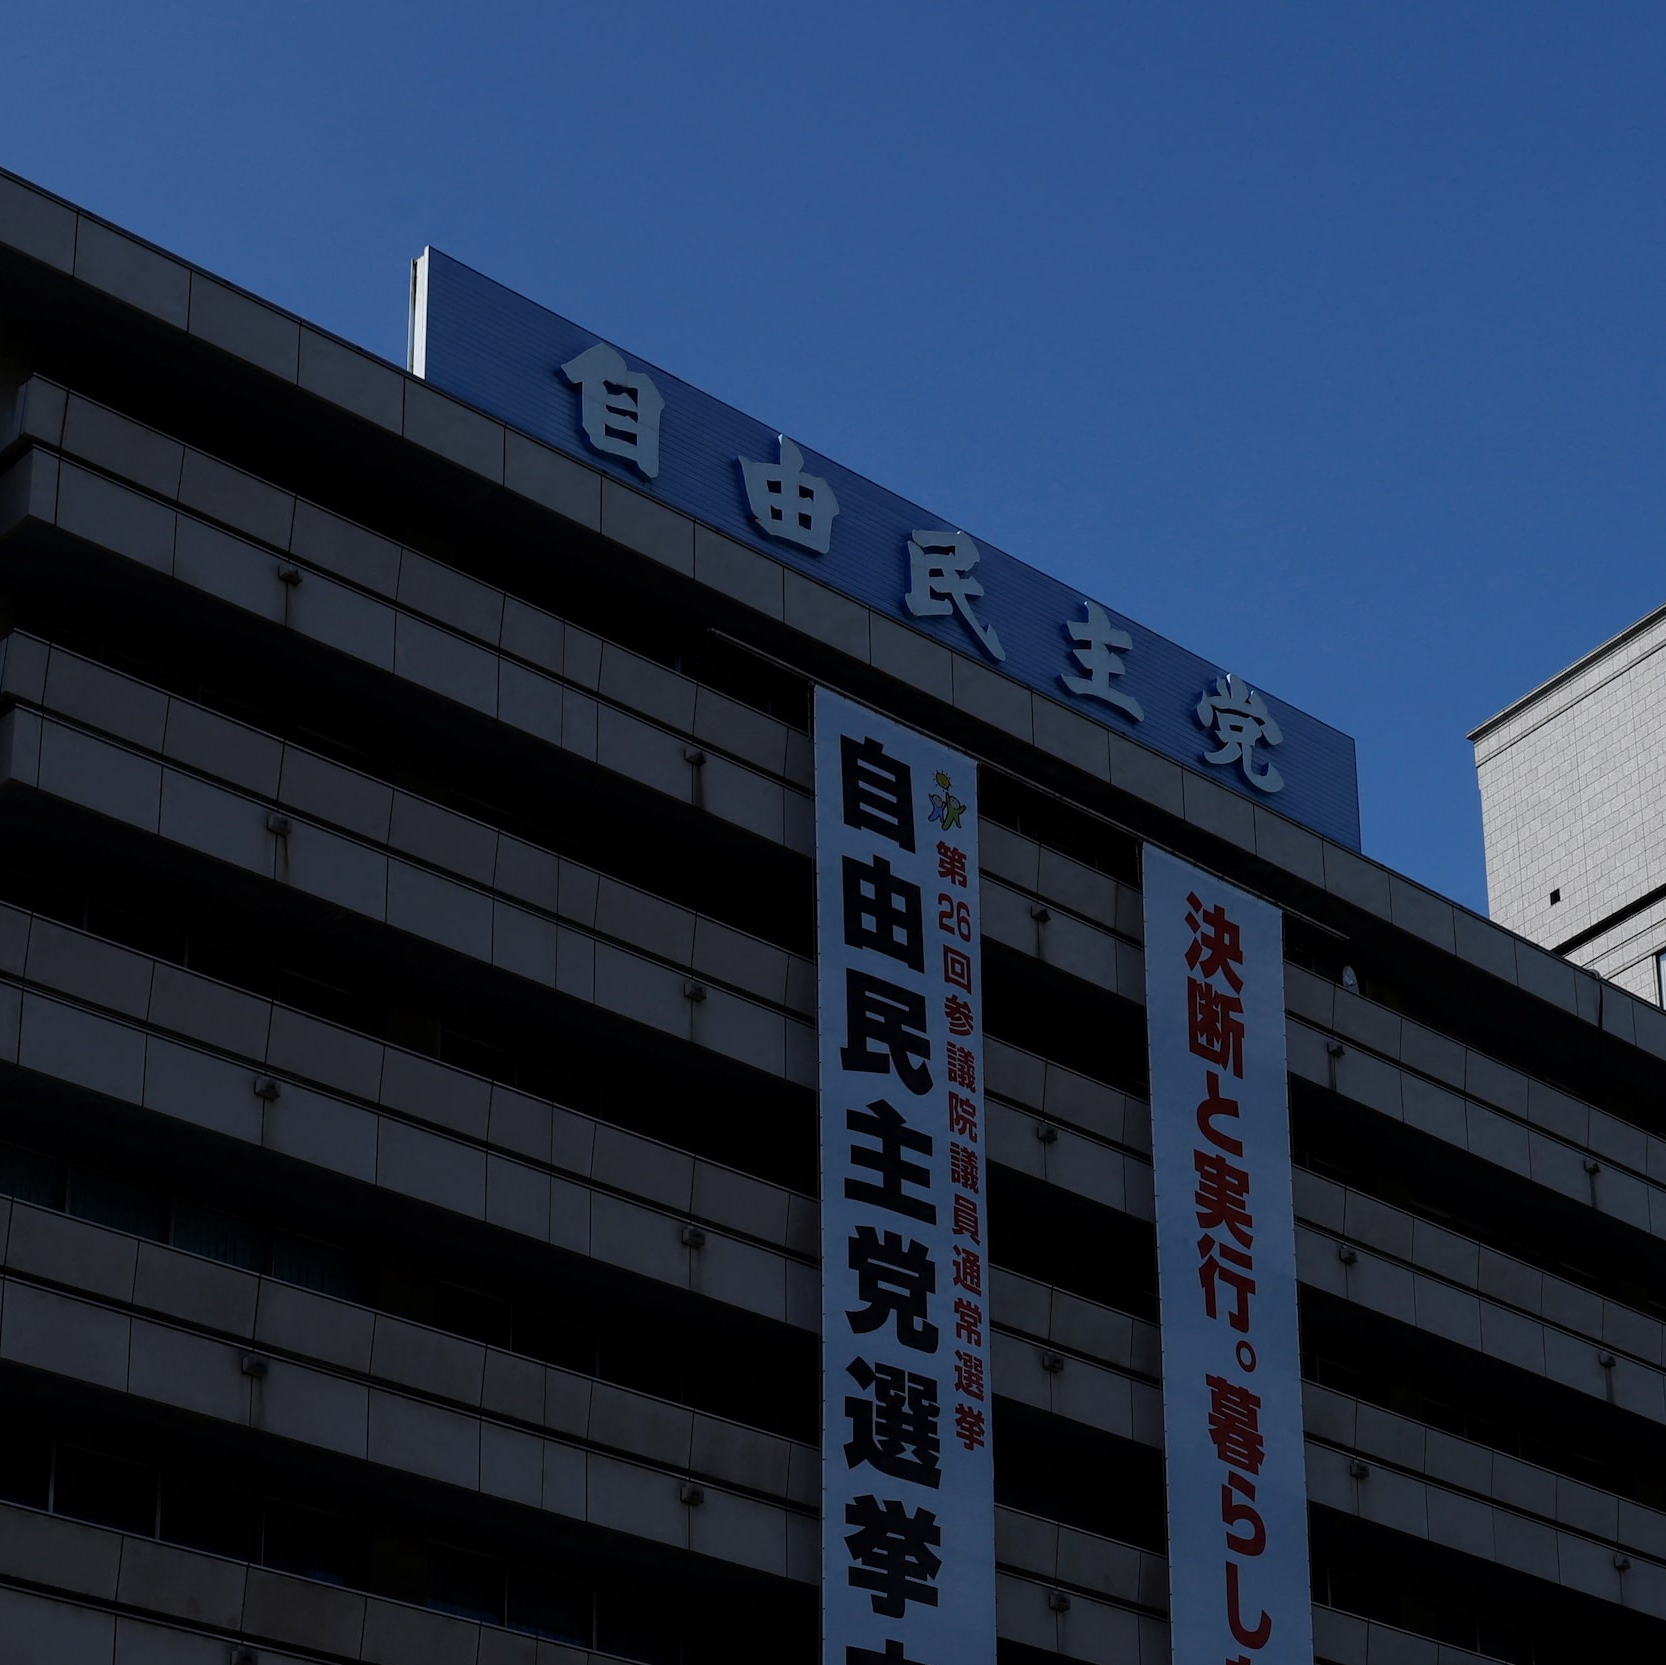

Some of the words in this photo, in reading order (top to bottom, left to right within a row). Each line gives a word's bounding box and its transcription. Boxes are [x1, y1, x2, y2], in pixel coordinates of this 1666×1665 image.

[561, 342, 1285, 793] 自由民主党
[935, 839, 985, 1452] 第26回参議院議員通常選挙
